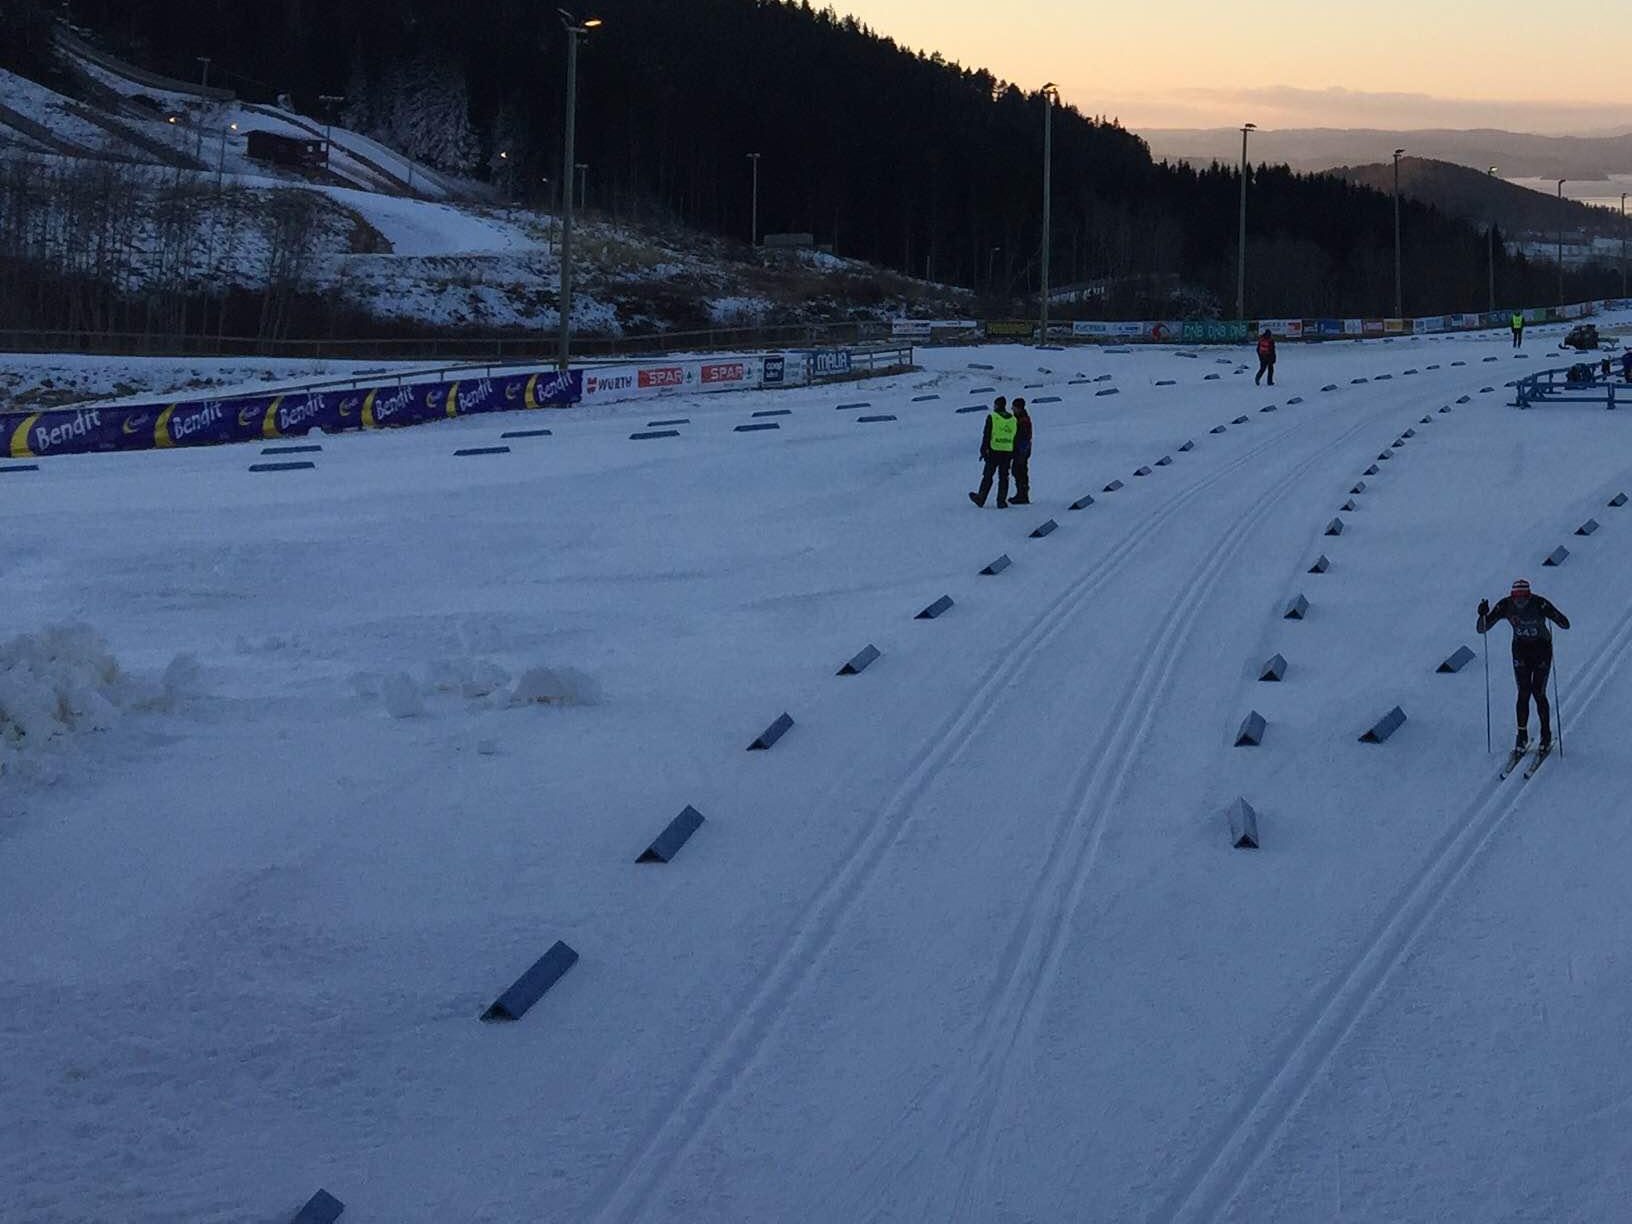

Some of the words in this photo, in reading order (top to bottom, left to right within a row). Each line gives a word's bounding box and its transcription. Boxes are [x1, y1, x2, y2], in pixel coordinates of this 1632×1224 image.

[534, 368, 576, 401] Bendit
[649, 369, 683, 386] SPAR
[710, 364, 742, 380] SPAR
[279, 390, 325, 429] Bendit
[374, 385, 415, 420] Bendit
[458, 378, 495, 412] Bendit
[35, 408, 102, 450] Bendit
[171, 401, 223, 440] Bendit
